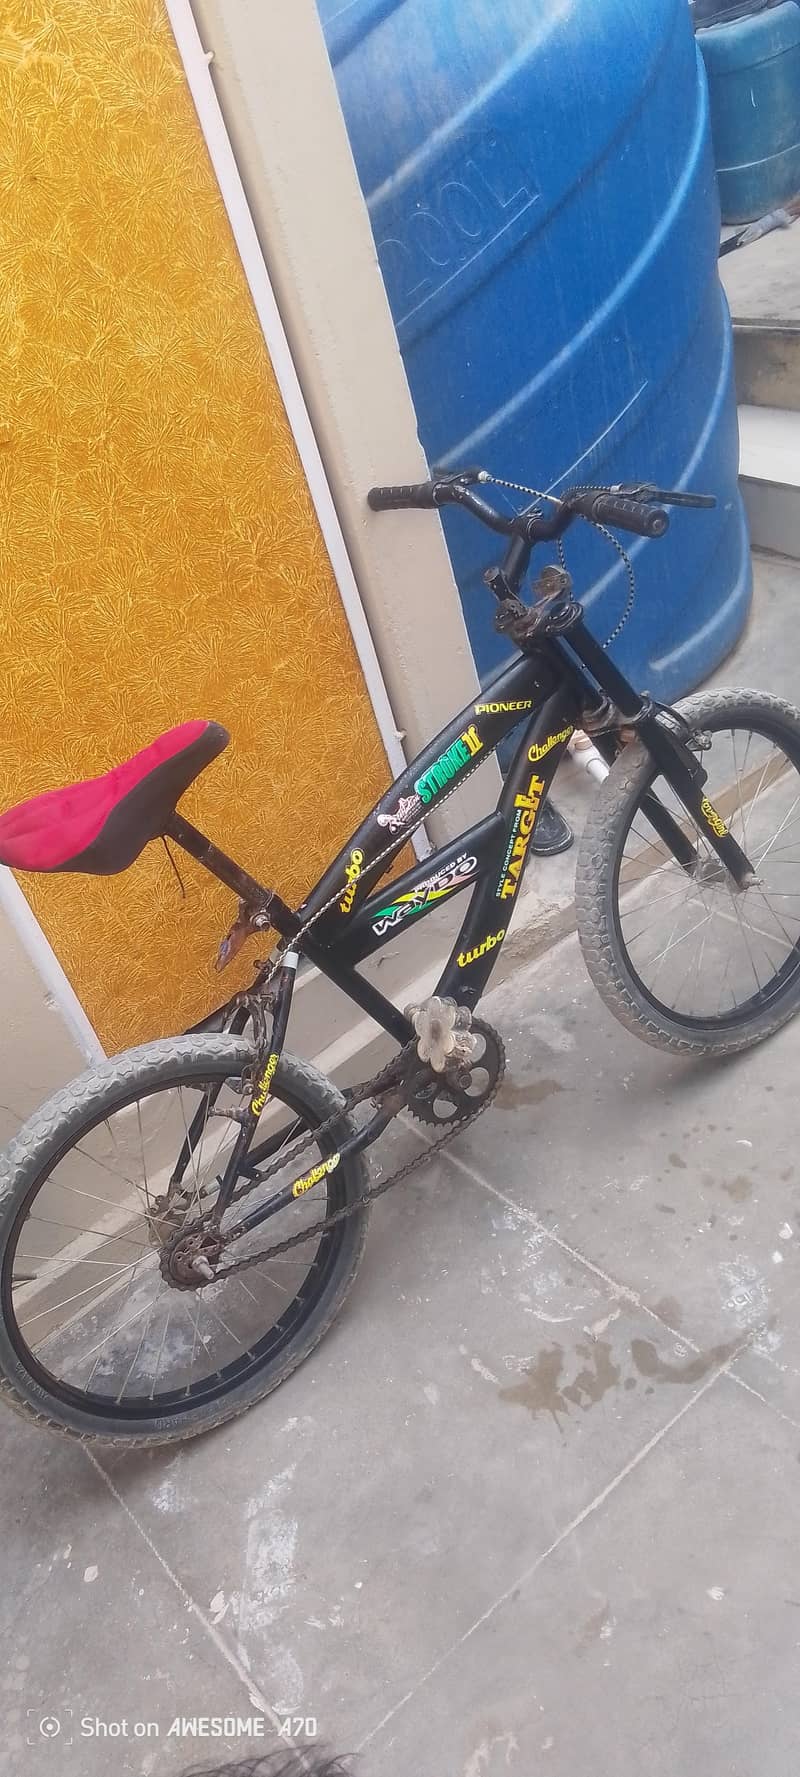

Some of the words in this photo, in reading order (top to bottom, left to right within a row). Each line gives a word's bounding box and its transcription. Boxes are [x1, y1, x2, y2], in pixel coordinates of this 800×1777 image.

[474, 700, 532, 715] PIONEER
[496, 873, 506, 897] STYLE
[502, 834, 516, 872] CONCEPT
[512, 809, 522, 832] FROM
[500, 775, 545, 899] TARGET
[456, 852, 468, 863] BY
[457, 929, 506, 967] turbo
